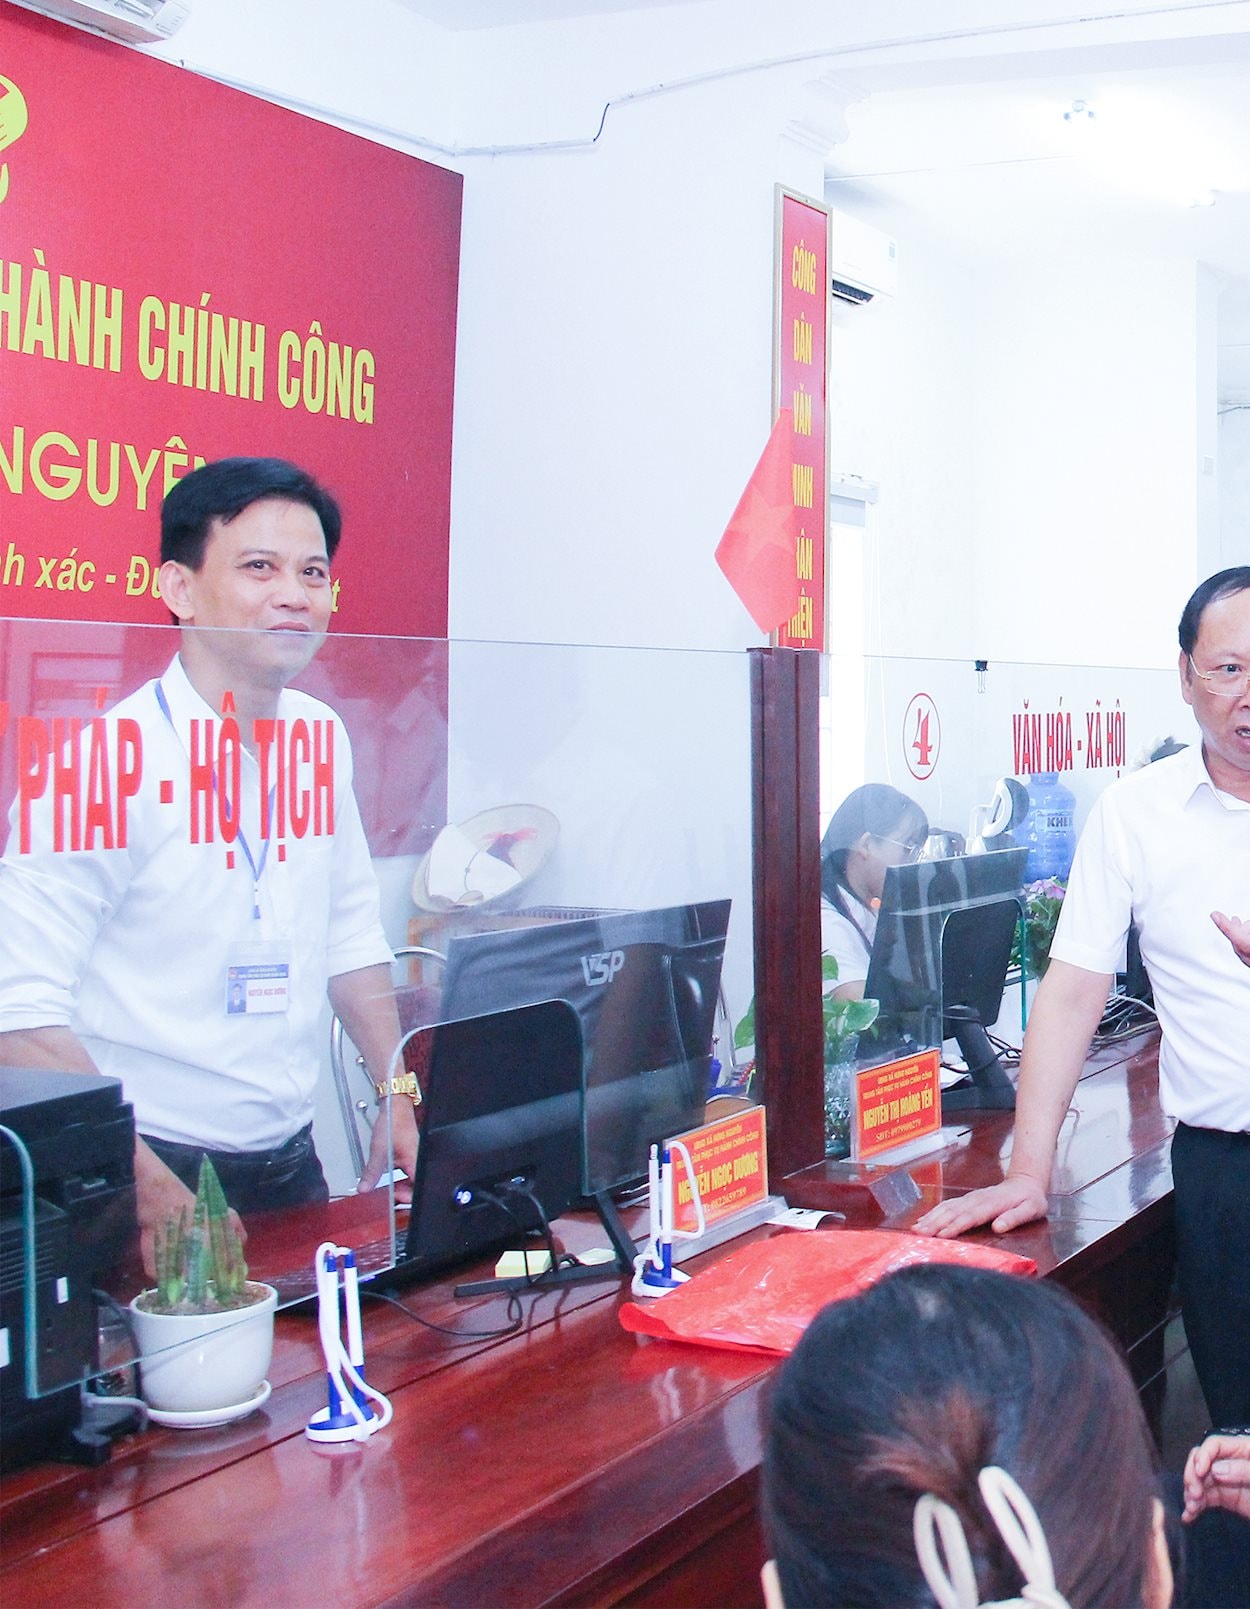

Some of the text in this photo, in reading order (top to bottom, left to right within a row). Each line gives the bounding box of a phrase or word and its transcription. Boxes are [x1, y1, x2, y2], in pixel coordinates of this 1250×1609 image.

[792, 239, 817, 295] CÔNG
[0, 247, 375, 424] HÀNH CHÍNH CÔNG
[793, 312, 812, 365] DÂN
[793, 384, 812, 436] VĂN
[0, 425, 207, 511] NGUYÊ
[34, 547, 96, 593] xác
[912, 708, 933, 765] 4
[1012, 698, 1042, 775] VĂN
[1047, 696, 1073, 772] HÓA
[1086, 699, 1103, 769] XÃ
[1106, 698, 1125, 778] HỘI
[18, 687, 335, 869] PHÁP - HỘ TỊCH
[863, 1098, 889, 1130] NGUYỄN
[711, 1162, 733, 1191] NGỌC
